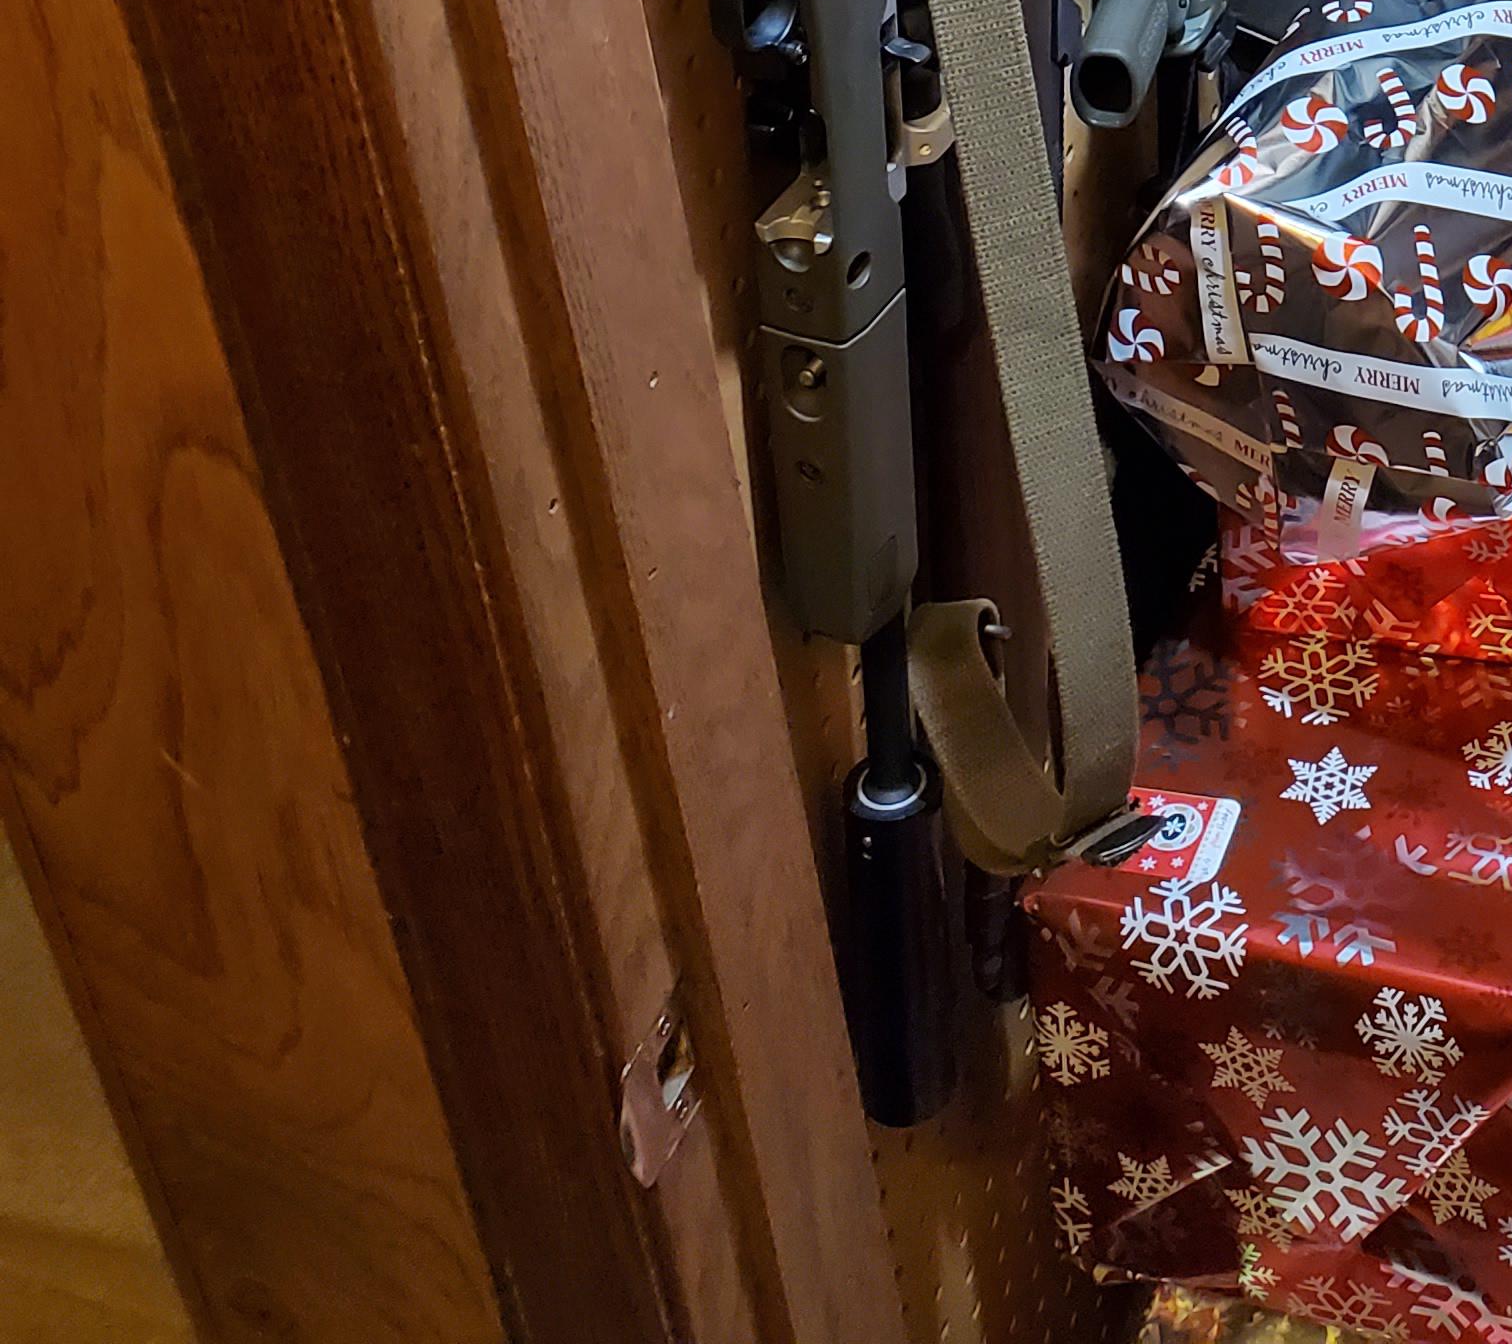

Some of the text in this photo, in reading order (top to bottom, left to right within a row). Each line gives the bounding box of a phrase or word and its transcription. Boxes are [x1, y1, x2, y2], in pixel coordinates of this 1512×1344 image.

[1381, 10, 1486, 44] christmas
[1298, 38, 1365, 67] MERRY
[1341, 171, 1408, 207] MERRY
[1201, 256, 1233, 356] christmas
[1353, 365, 1421, 396] MERRY
